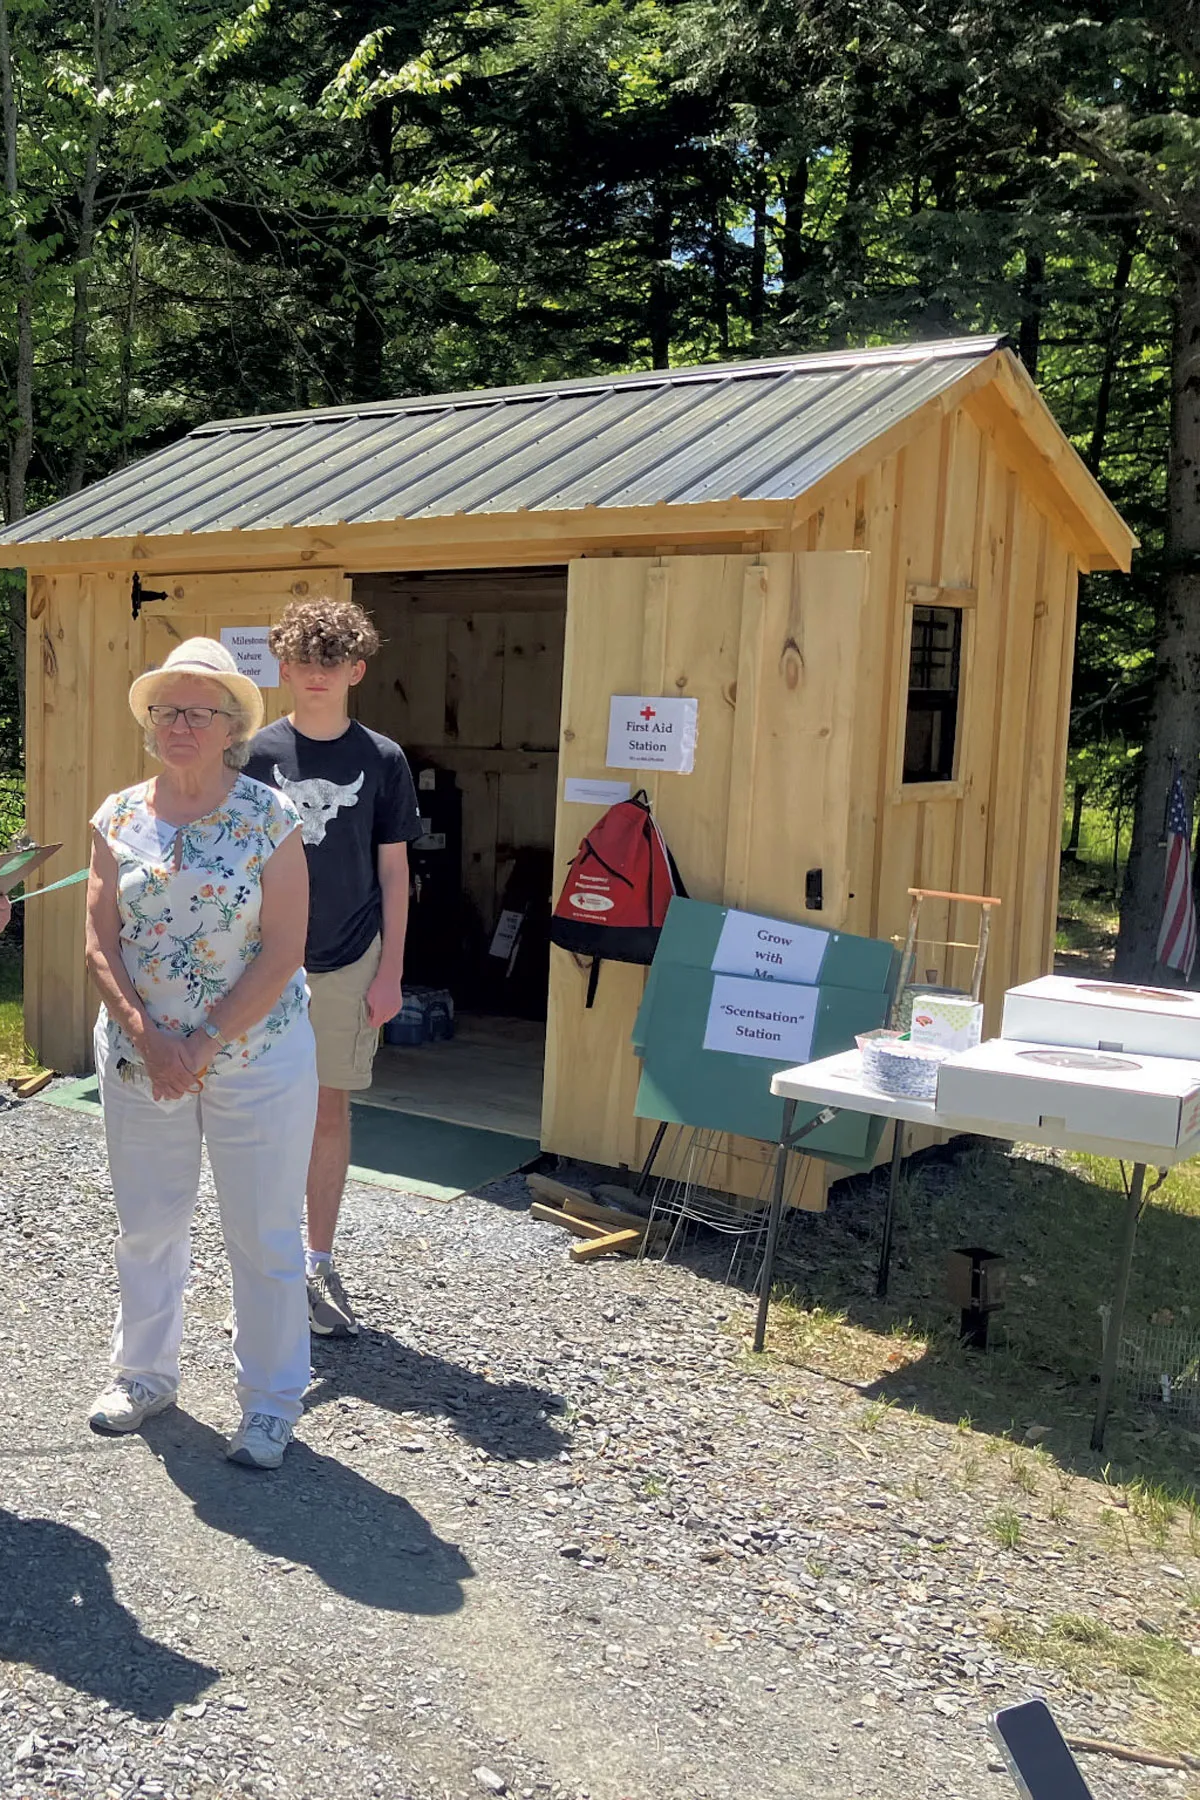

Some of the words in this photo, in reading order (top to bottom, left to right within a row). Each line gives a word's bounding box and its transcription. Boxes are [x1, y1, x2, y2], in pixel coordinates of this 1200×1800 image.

[237, 652, 262, 660] Nature
[626, 721, 649, 732] First
[652, 723, 673, 733] Aid
[628, 740, 667, 752] Station
[757, 929, 793, 946] Grow
[755, 950, 783, 965] with
[735, 1025, 782, 1041] Station
